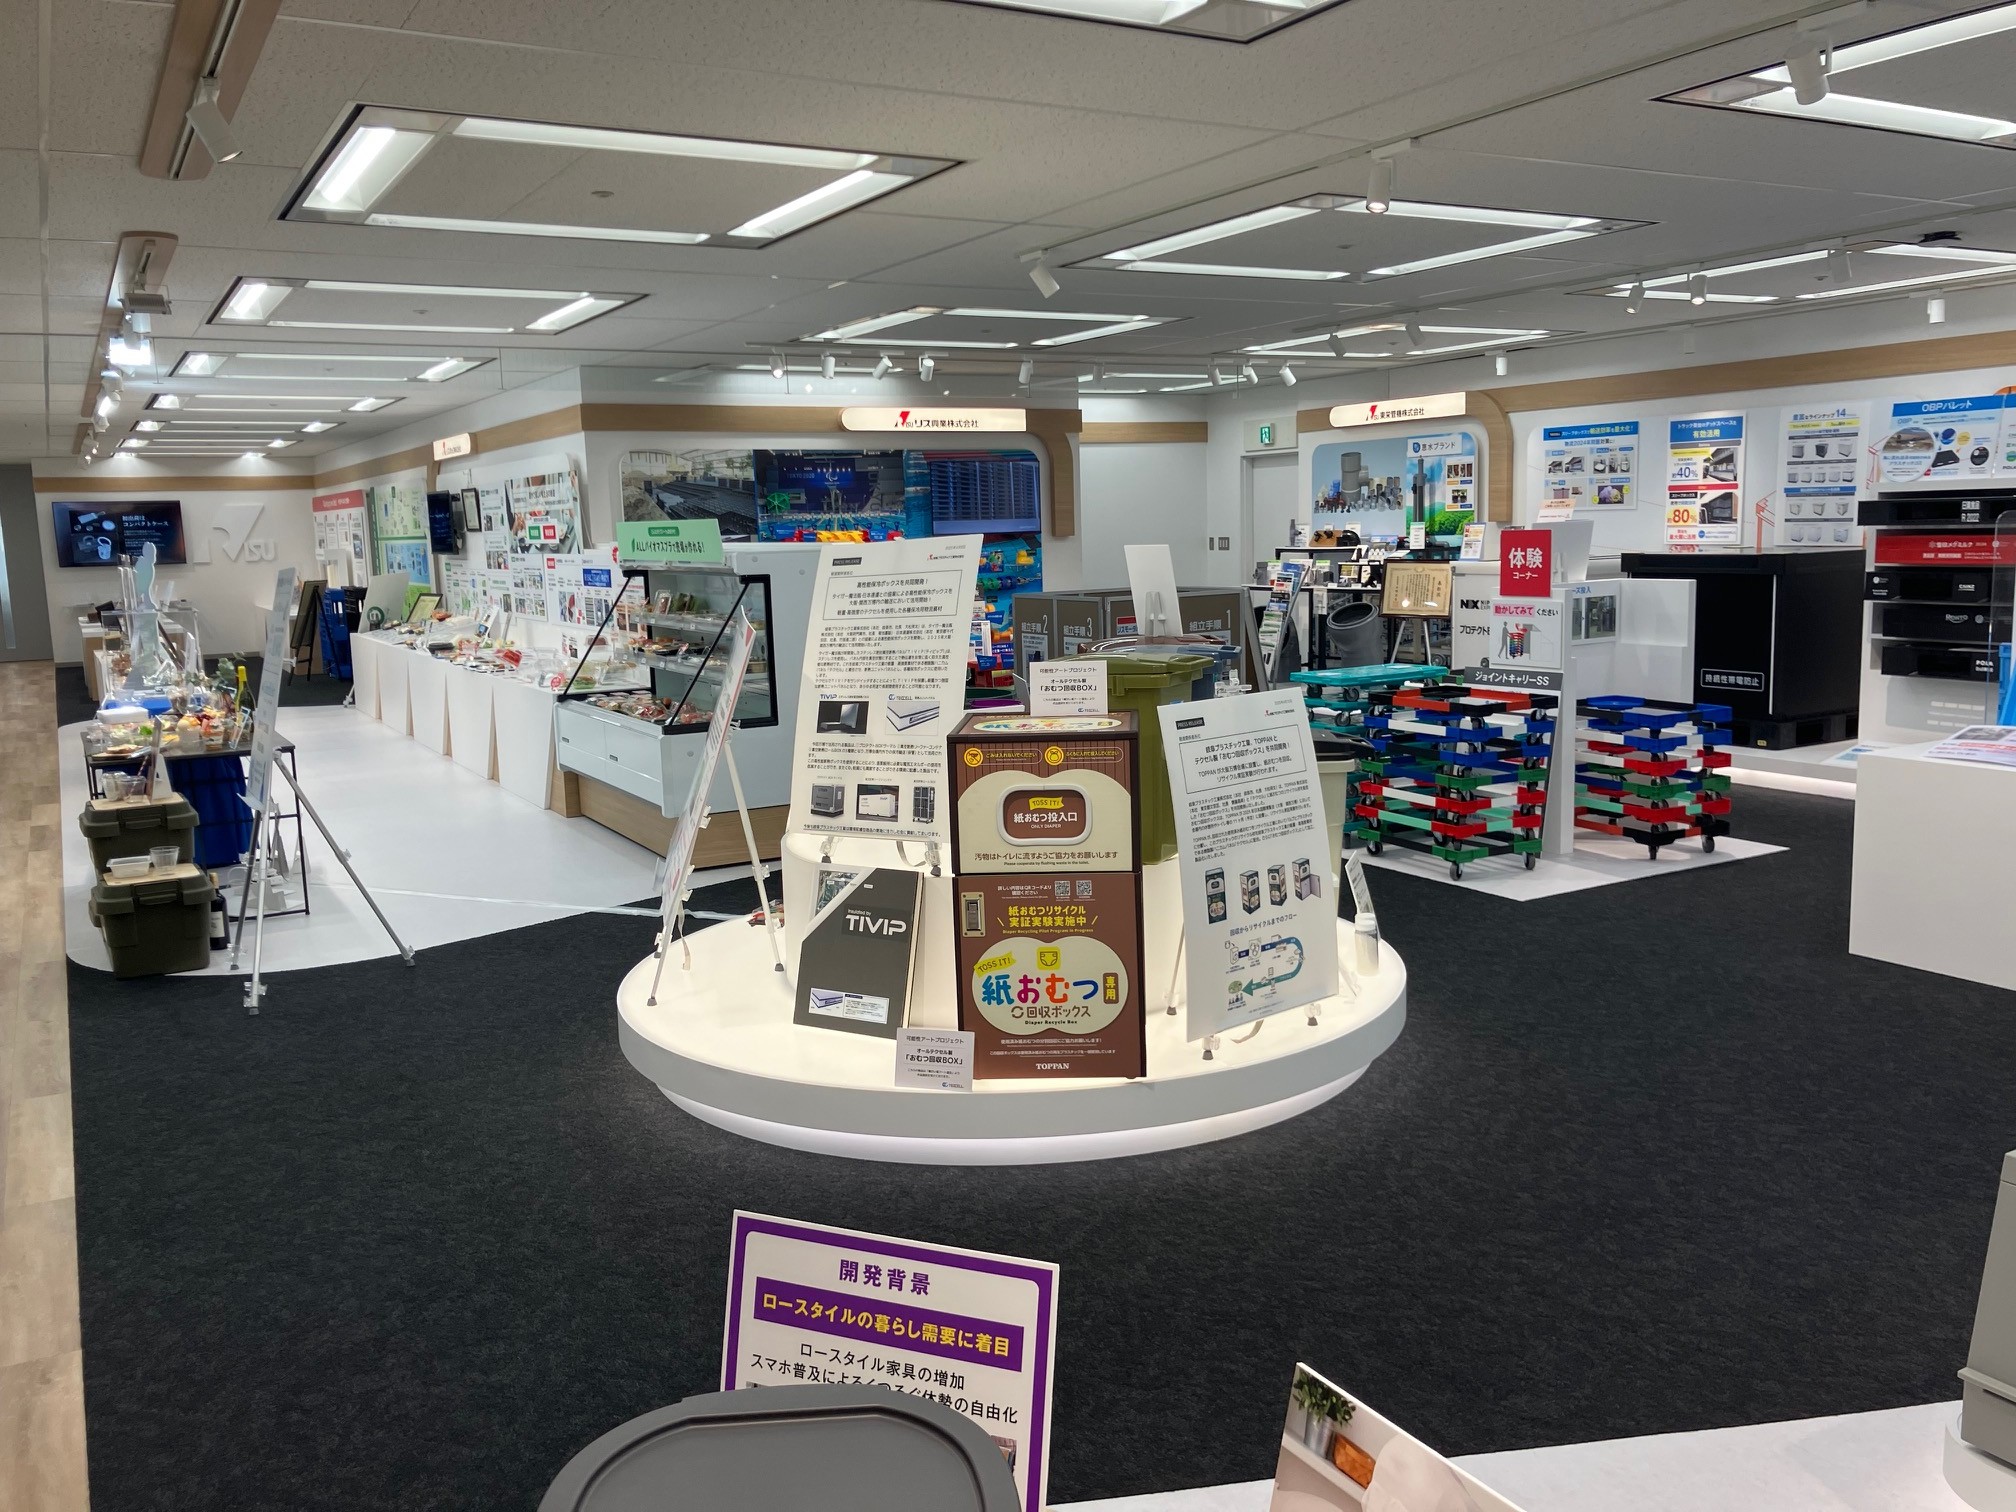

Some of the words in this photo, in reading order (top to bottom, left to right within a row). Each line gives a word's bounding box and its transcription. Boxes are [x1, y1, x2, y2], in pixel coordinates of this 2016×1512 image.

[1922, 400, 1973, 412] OBPパレット
[1380, 408, 1425, 420] 東栄管機株式会社
[1836, 408, 1847, 418] 14
[1421, 441, 1456, 452] 恵水ブランド
[1508, 547, 1543, 569] 体験
[1513, 571, 1539, 580] コーナー
[1494, 605, 1534, 615] 動かしてみて
[1537, 608, 1558, 616] ください
[1021, 622, 1042, 634] 組立手順
[1042, 614, 1048, 634] 2
[1189, 619, 1221, 631] 組立手順
[1226, 609, 1231, 629] 1
[1063, 625, 1086, 638] 組立手順
[1086, 617, 1093, 637] 3
[1475, 671, 1550, 686] ジョイントキャリーSS
[1705, 673, 1760, 687] 持続性帯電防止
[1040, 684, 1097, 692] 「おむつ回収BOX」
[1032, 799, 1049, 808] TOSS
[1050, 799, 1061, 807] IT!
[1013, 811, 1078, 824] 紙おむつ投入口
[974, 851, 1118, 861] 汚物はトイレに流すようご協力をお願いします
[1008, 905, 1087, 916] 紙おむつリサイクル
[845, 914, 907, 936] TIVIP
[1009, 916, 1087, 928] 実証実験実施中
[977, 961, 998, 973] TOSS
[998, 957, 1011, 967] IT!
[982, 973, 1099, 1005] 紙おむつ
[1105, 975, 1117, 1001] 専用
[1026, 1005, 1091, 1018] 回収ボックス
[906, 1035, 964, 1044] 可能性アートプロジェクト
[906, 1054, 963, 1065] 「おむつ回収BOX」
[1036, 1062, 1070, 1070] TOPPAN
[838, 1259, 931, 1297] 開発背景
[762, 1292, 1010, 1357] ロースタイルの暮らし需要に着目
[800, 1342, 966, 1391] ロースタイル家具の増加
